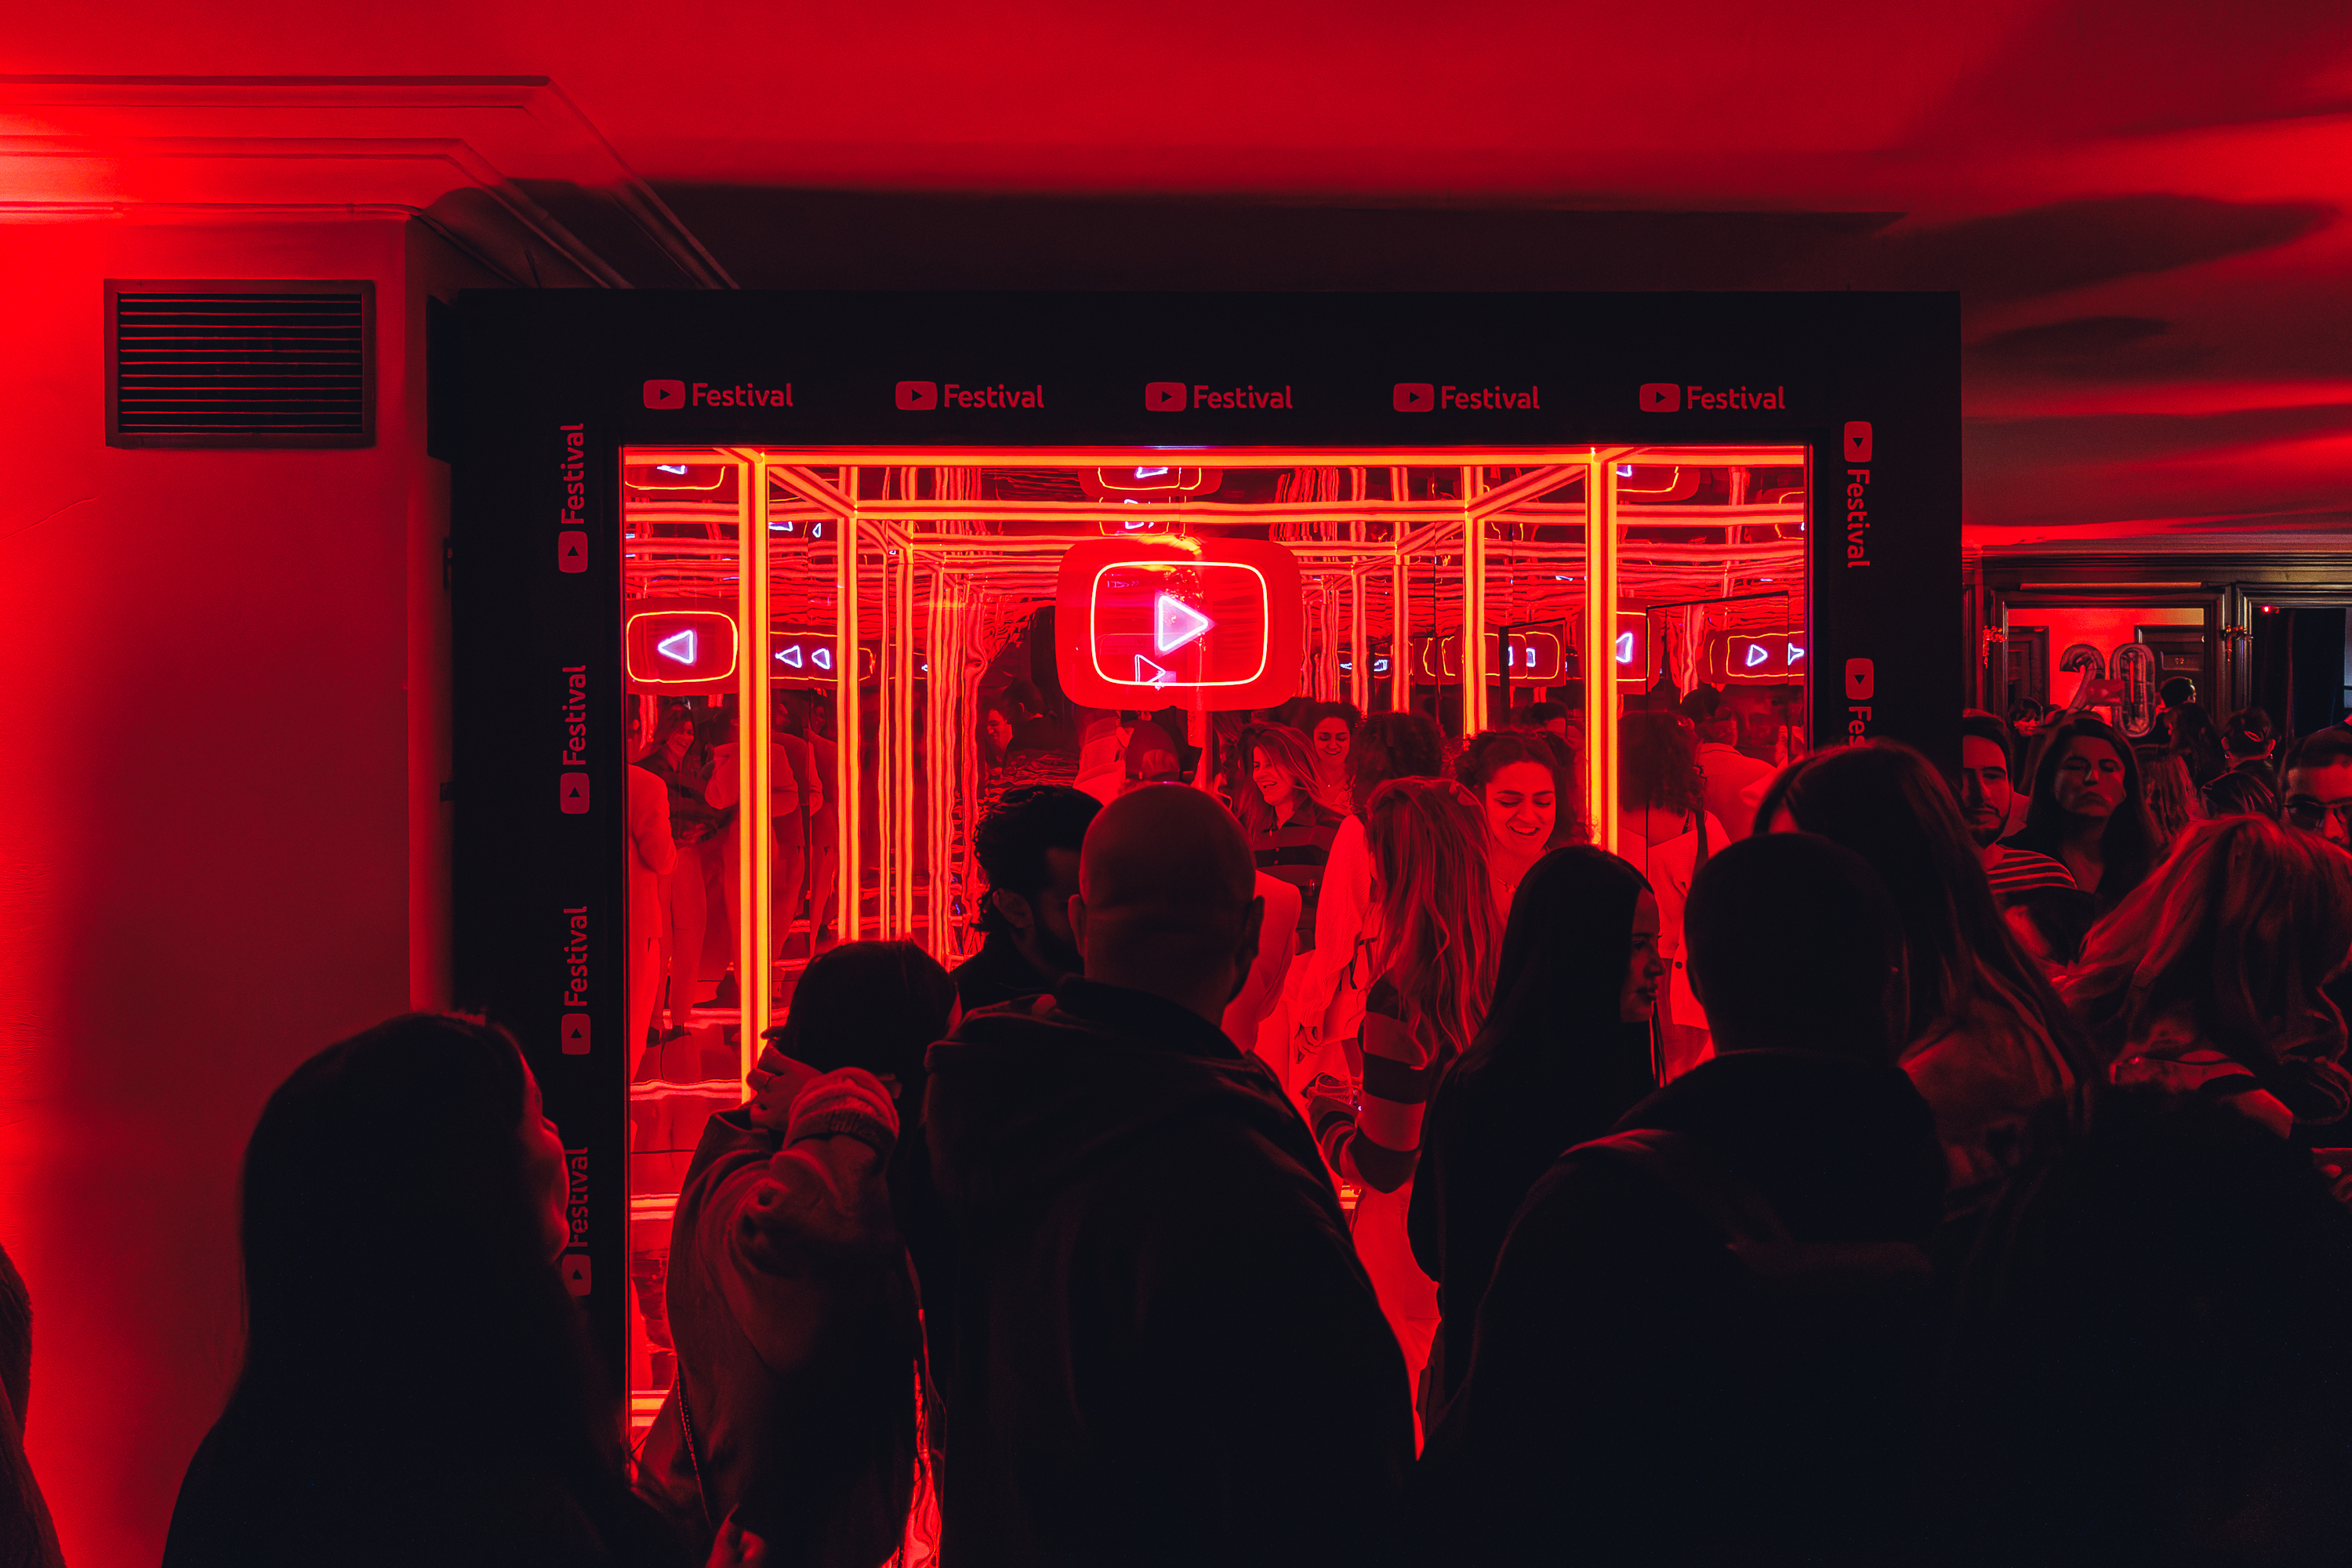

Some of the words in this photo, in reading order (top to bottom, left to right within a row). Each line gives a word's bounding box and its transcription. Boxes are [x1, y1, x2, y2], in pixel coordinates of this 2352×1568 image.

[693, 383, 793, 407] Festival
[945, 384, 1044, 408] Festival
[1194, 385, 1293, 408] Festival
[1442, 386, 1540, 409] Festival
[1688, 386, 1785, 409] Festival
[561, 423, 584, 523] Festival
[1847, 470, 1871, 568] Festival
[562, 666, 586, 765] Festival
[564, 906, 587, 1006] Festival
